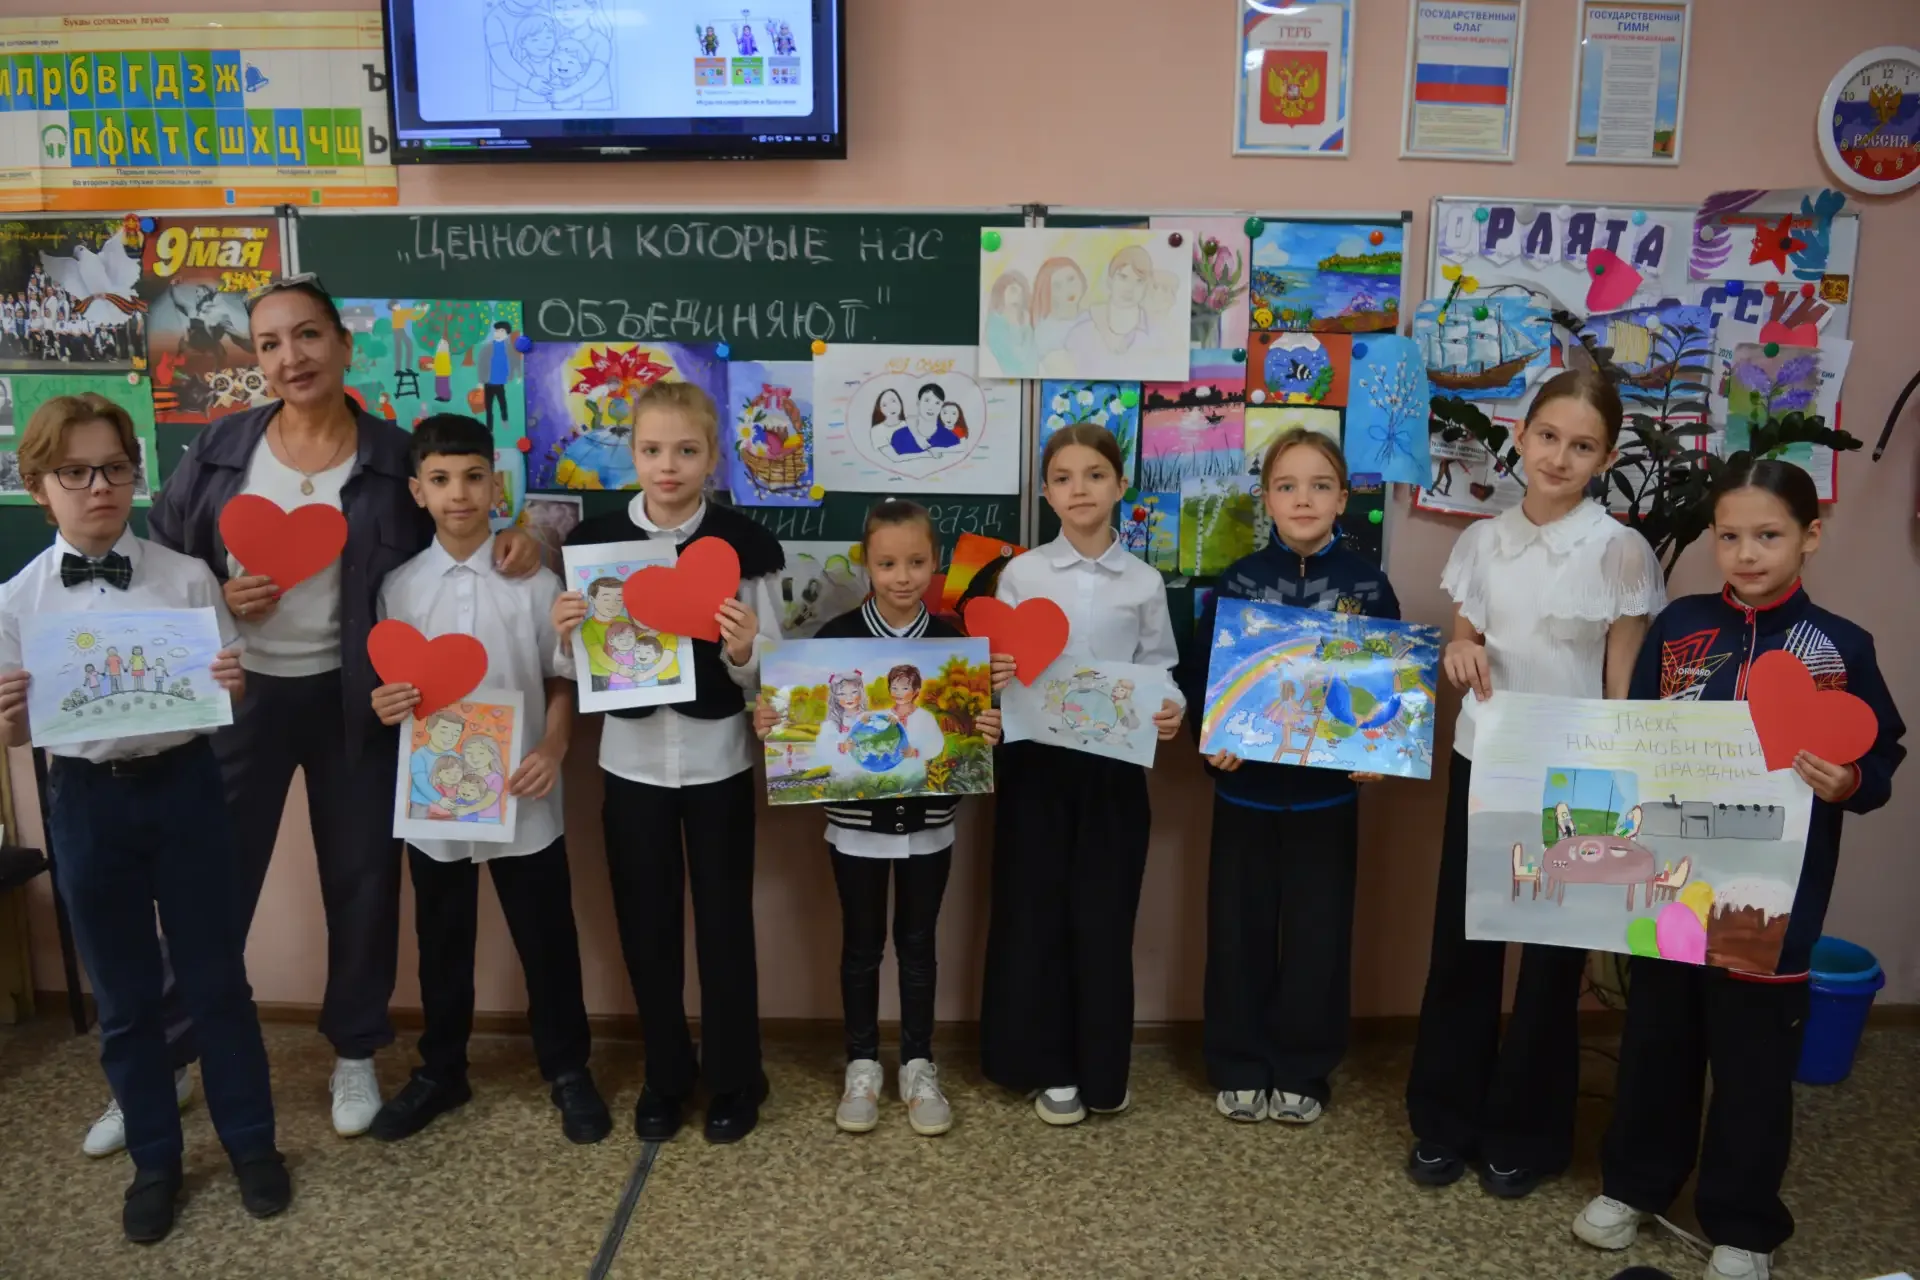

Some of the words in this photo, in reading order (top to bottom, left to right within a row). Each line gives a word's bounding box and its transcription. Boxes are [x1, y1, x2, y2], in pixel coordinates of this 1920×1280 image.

[1420, 8, 1516, 21] ГОСУДАРСТВЕННЫЙ
[1590, 10, 1680, 21] ГОСУДАРСТВЕННЫЙ
[1279, 26, 1312, 38] ГЕРБ
[1453, 22, 1482, 32] ФЛАГ
[1617, 22, 1649, 32] ГИМН
[1854, 133, 1909, 148] РОССИЯ
[636, 222, 834, 264] КОТОРЫЕ
[1446, 206, 1665, 268] ОРЛЯТА
[152, 226, 189, 277] 9
[1565, 734, 1615, 751] НАШ
[1654, 762, 1761, 782] ПРАЗДНИК
